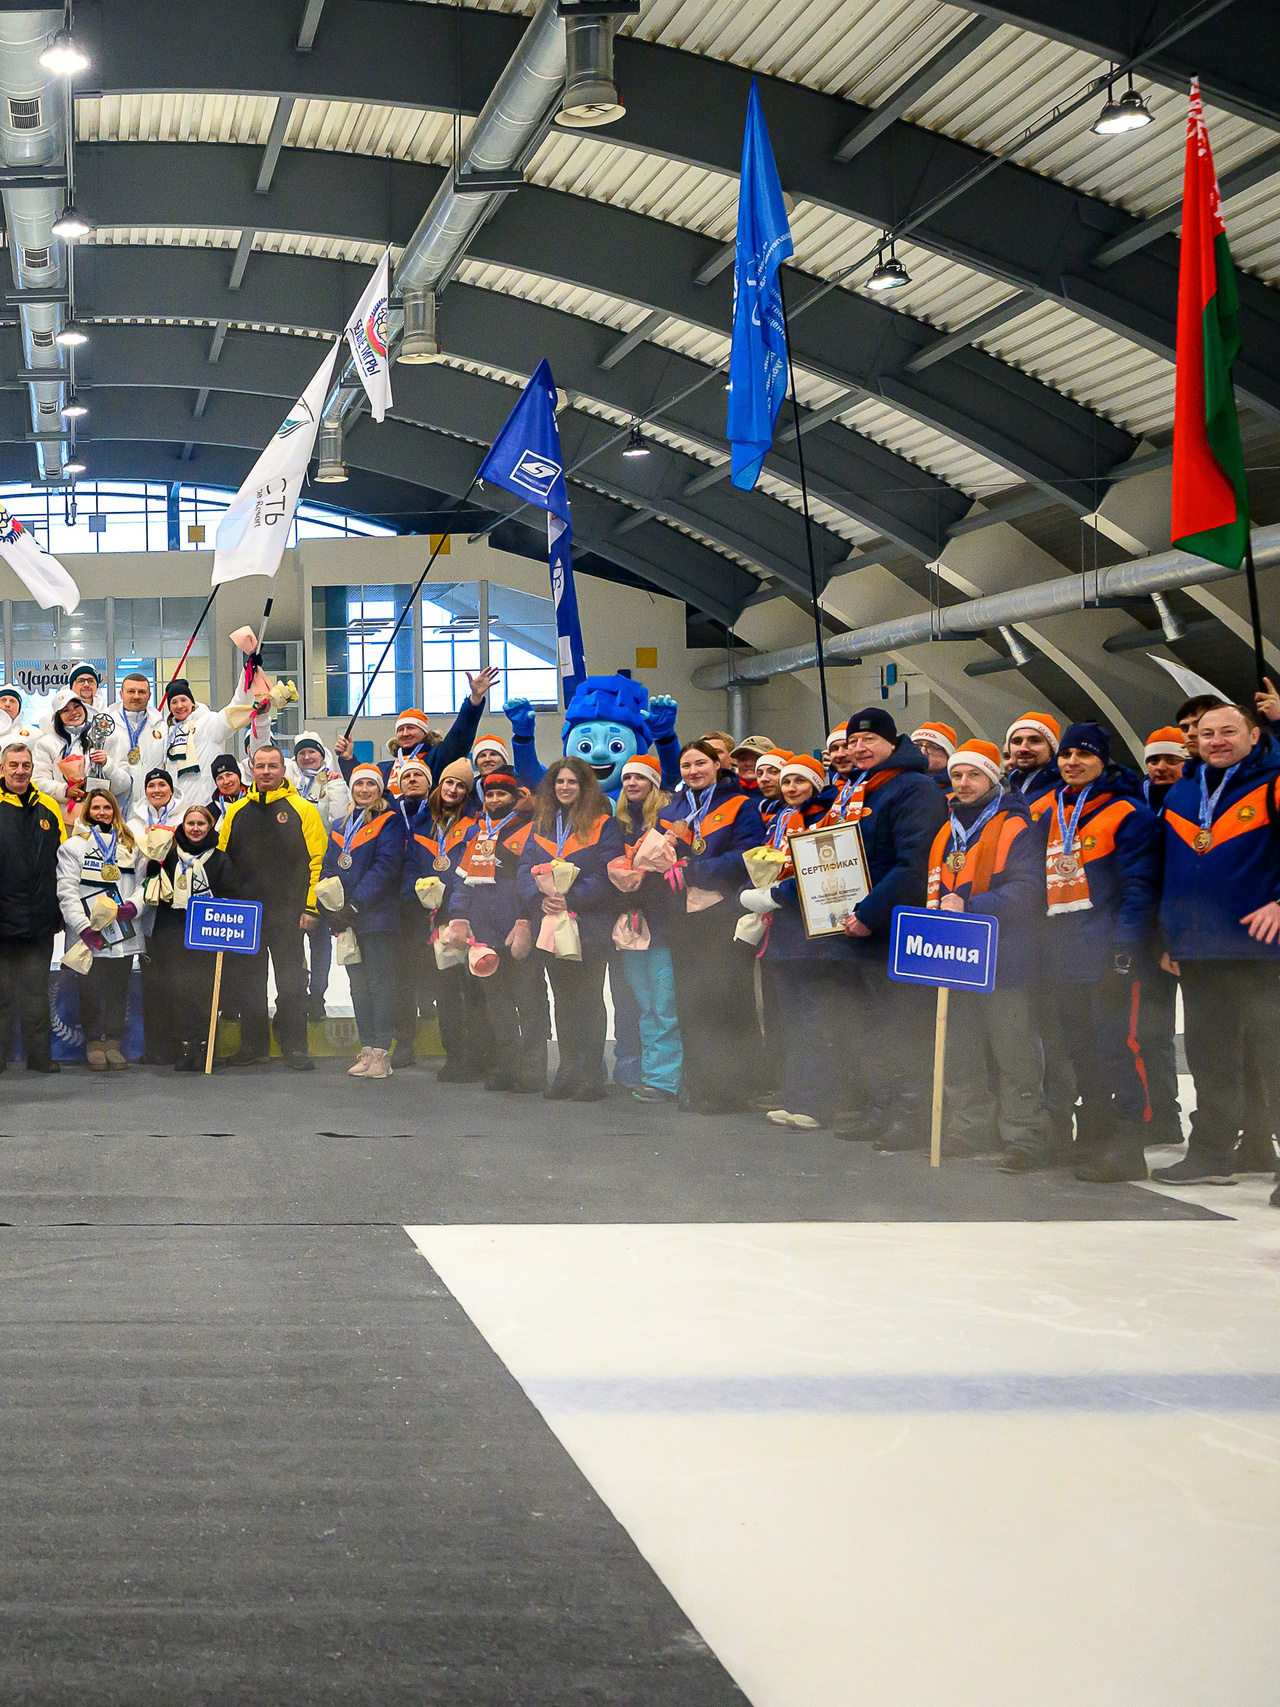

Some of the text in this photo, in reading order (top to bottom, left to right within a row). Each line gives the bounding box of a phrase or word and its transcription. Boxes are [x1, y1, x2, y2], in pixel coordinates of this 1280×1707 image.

[801, 857, 859, 876] СЕРТИФИКАТ
[204, 907, 245, 924] Белые
[201, 926, 245, 942] тигры
[906, 935, 980, 965] Молния
